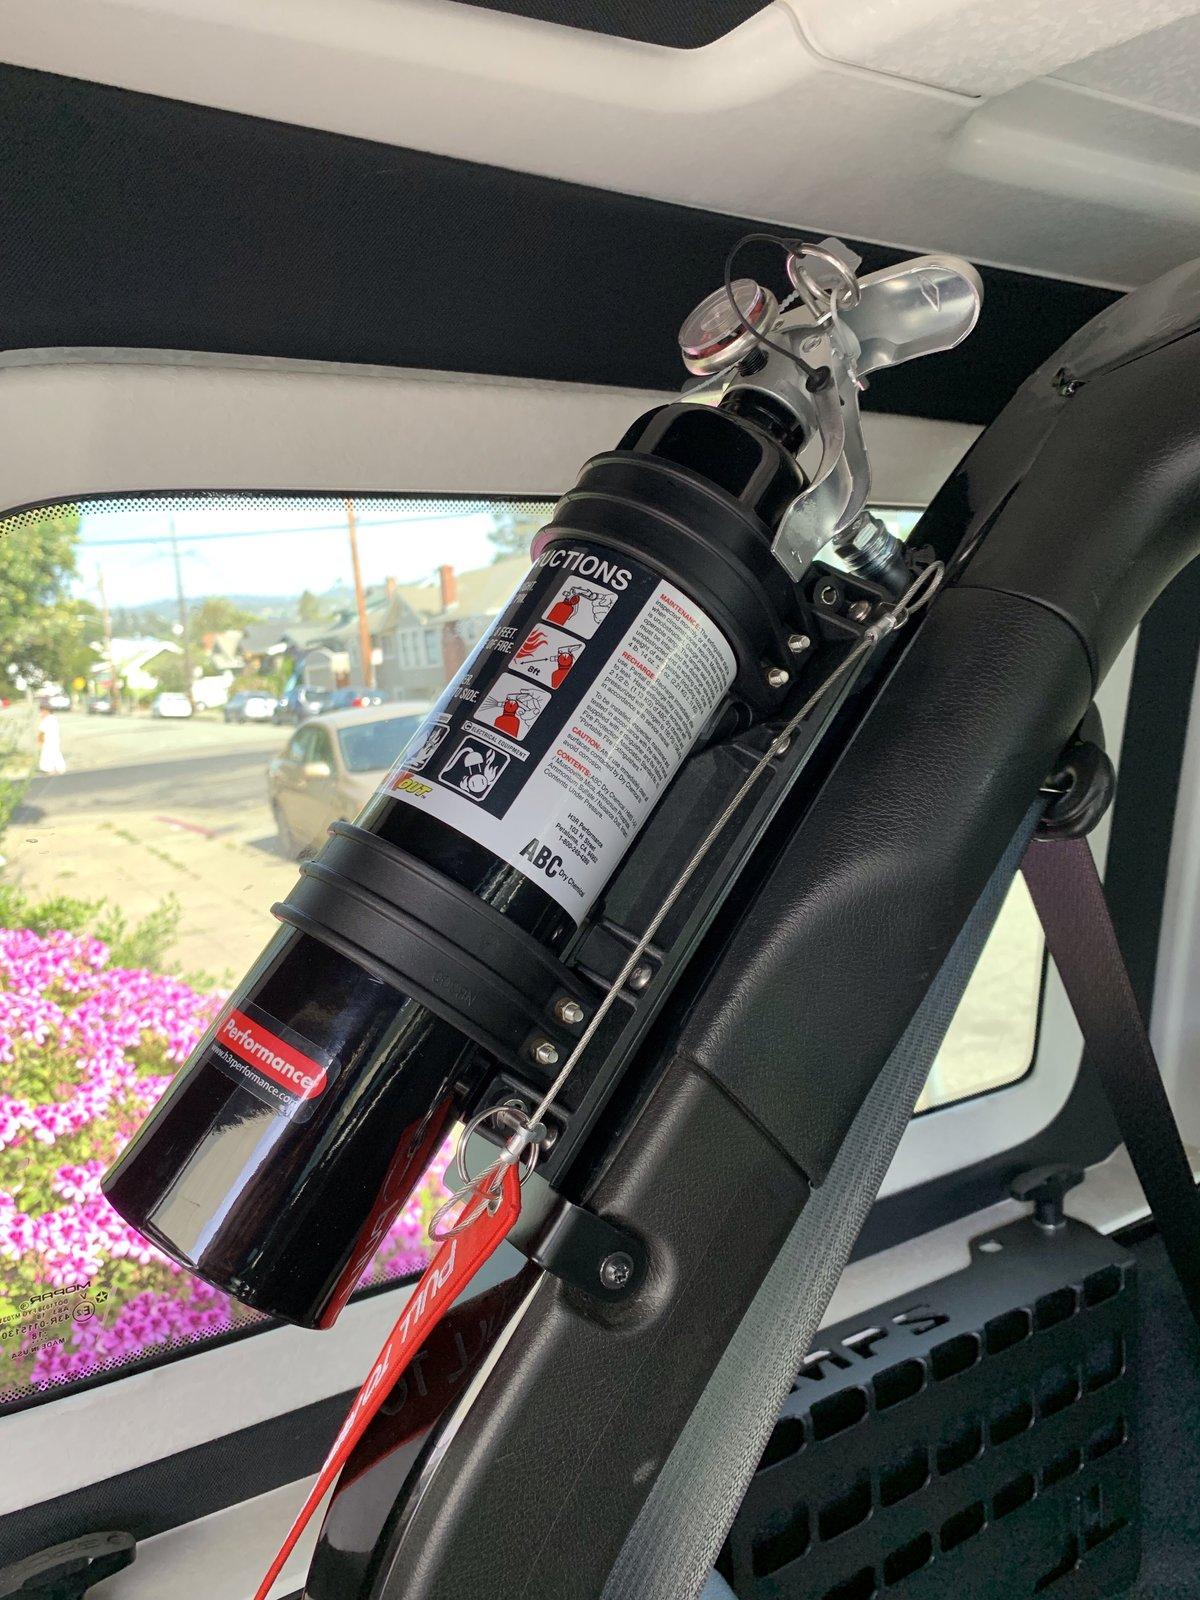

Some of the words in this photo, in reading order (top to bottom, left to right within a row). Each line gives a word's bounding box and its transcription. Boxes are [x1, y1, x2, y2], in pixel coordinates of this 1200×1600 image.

[653, 599, 680, 623] inspected
[659, 593, 700, 630] MAINTENANCE:
[500, 627, 518, 639] FEET.
[642, 617, 667, 638] operable
[494, 640, 514, 654] FIRE.
[635, 629, 668, 658] unobstructed
[460, 688, 480, 703] SIDE.
[470, 726, 498, 742] ELECTRICAL
[496, 738, 527, 759] EQUIPMENT
[562, 739, 578, 752] avoid
[571, 726, 601, 750] CAUTION:
[555, 749, 591, 778] CONTENTS:
[521, 835, 564, 877] ABC
[557, 868, 569, 882] Dry
[223, 1018, 319, 1090] Performance
